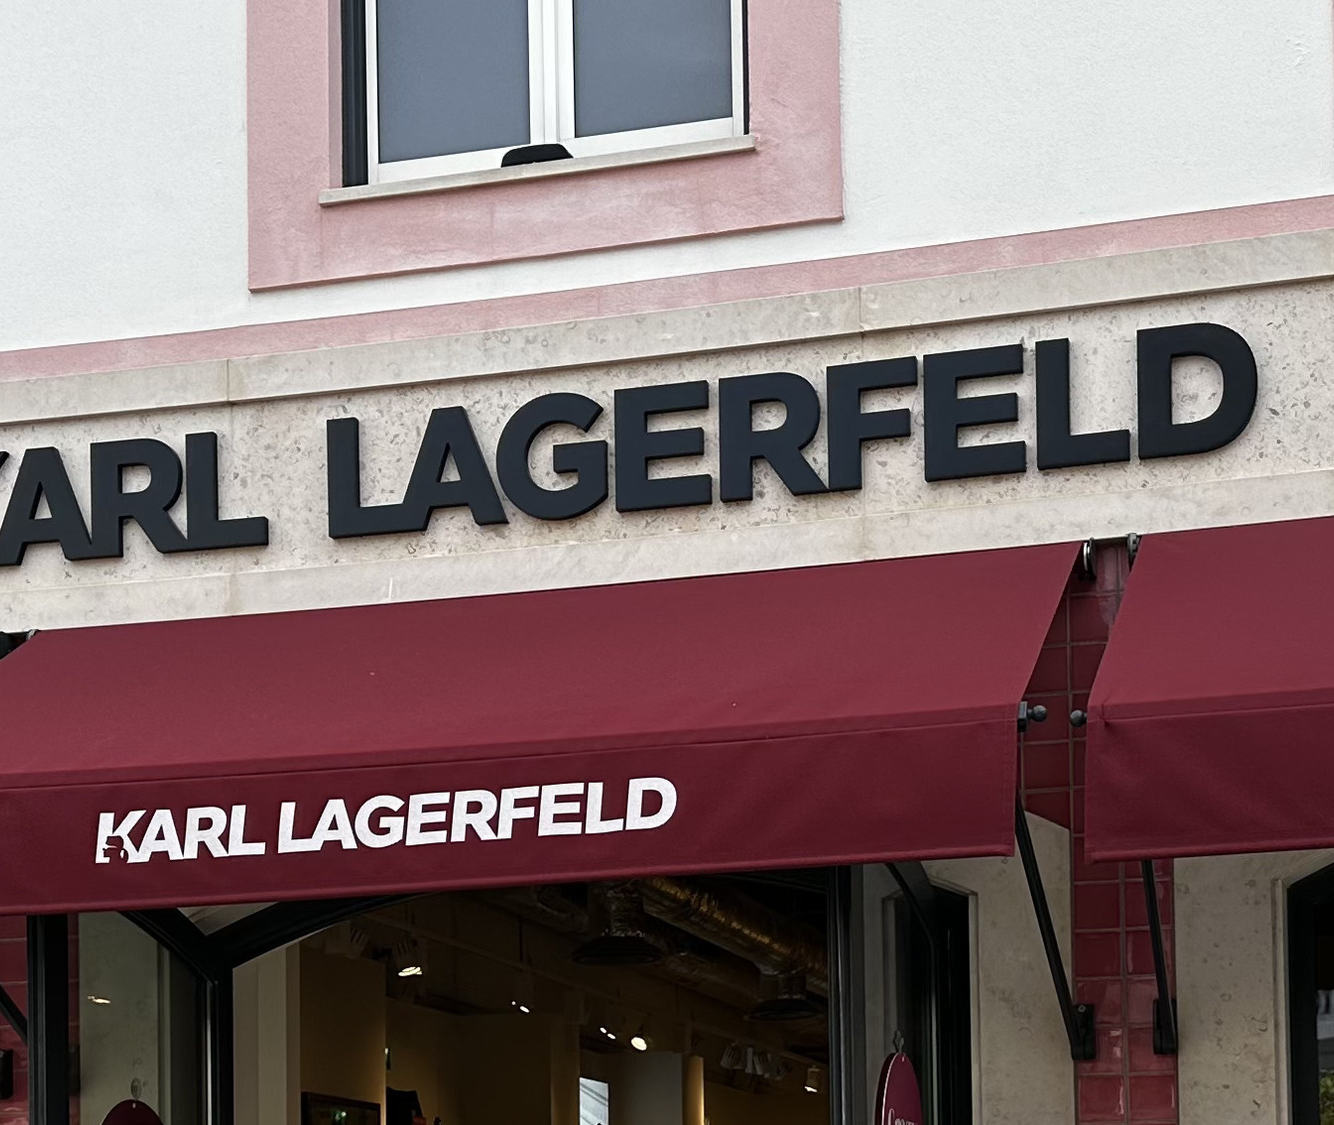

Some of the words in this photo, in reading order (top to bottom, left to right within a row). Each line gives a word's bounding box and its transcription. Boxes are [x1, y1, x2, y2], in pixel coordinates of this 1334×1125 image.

[327, 322, 1258, 539] LAGERFELD
[95, 805, 266, 864] KARL
[277, 777, 677, 855] LAGERFELD
